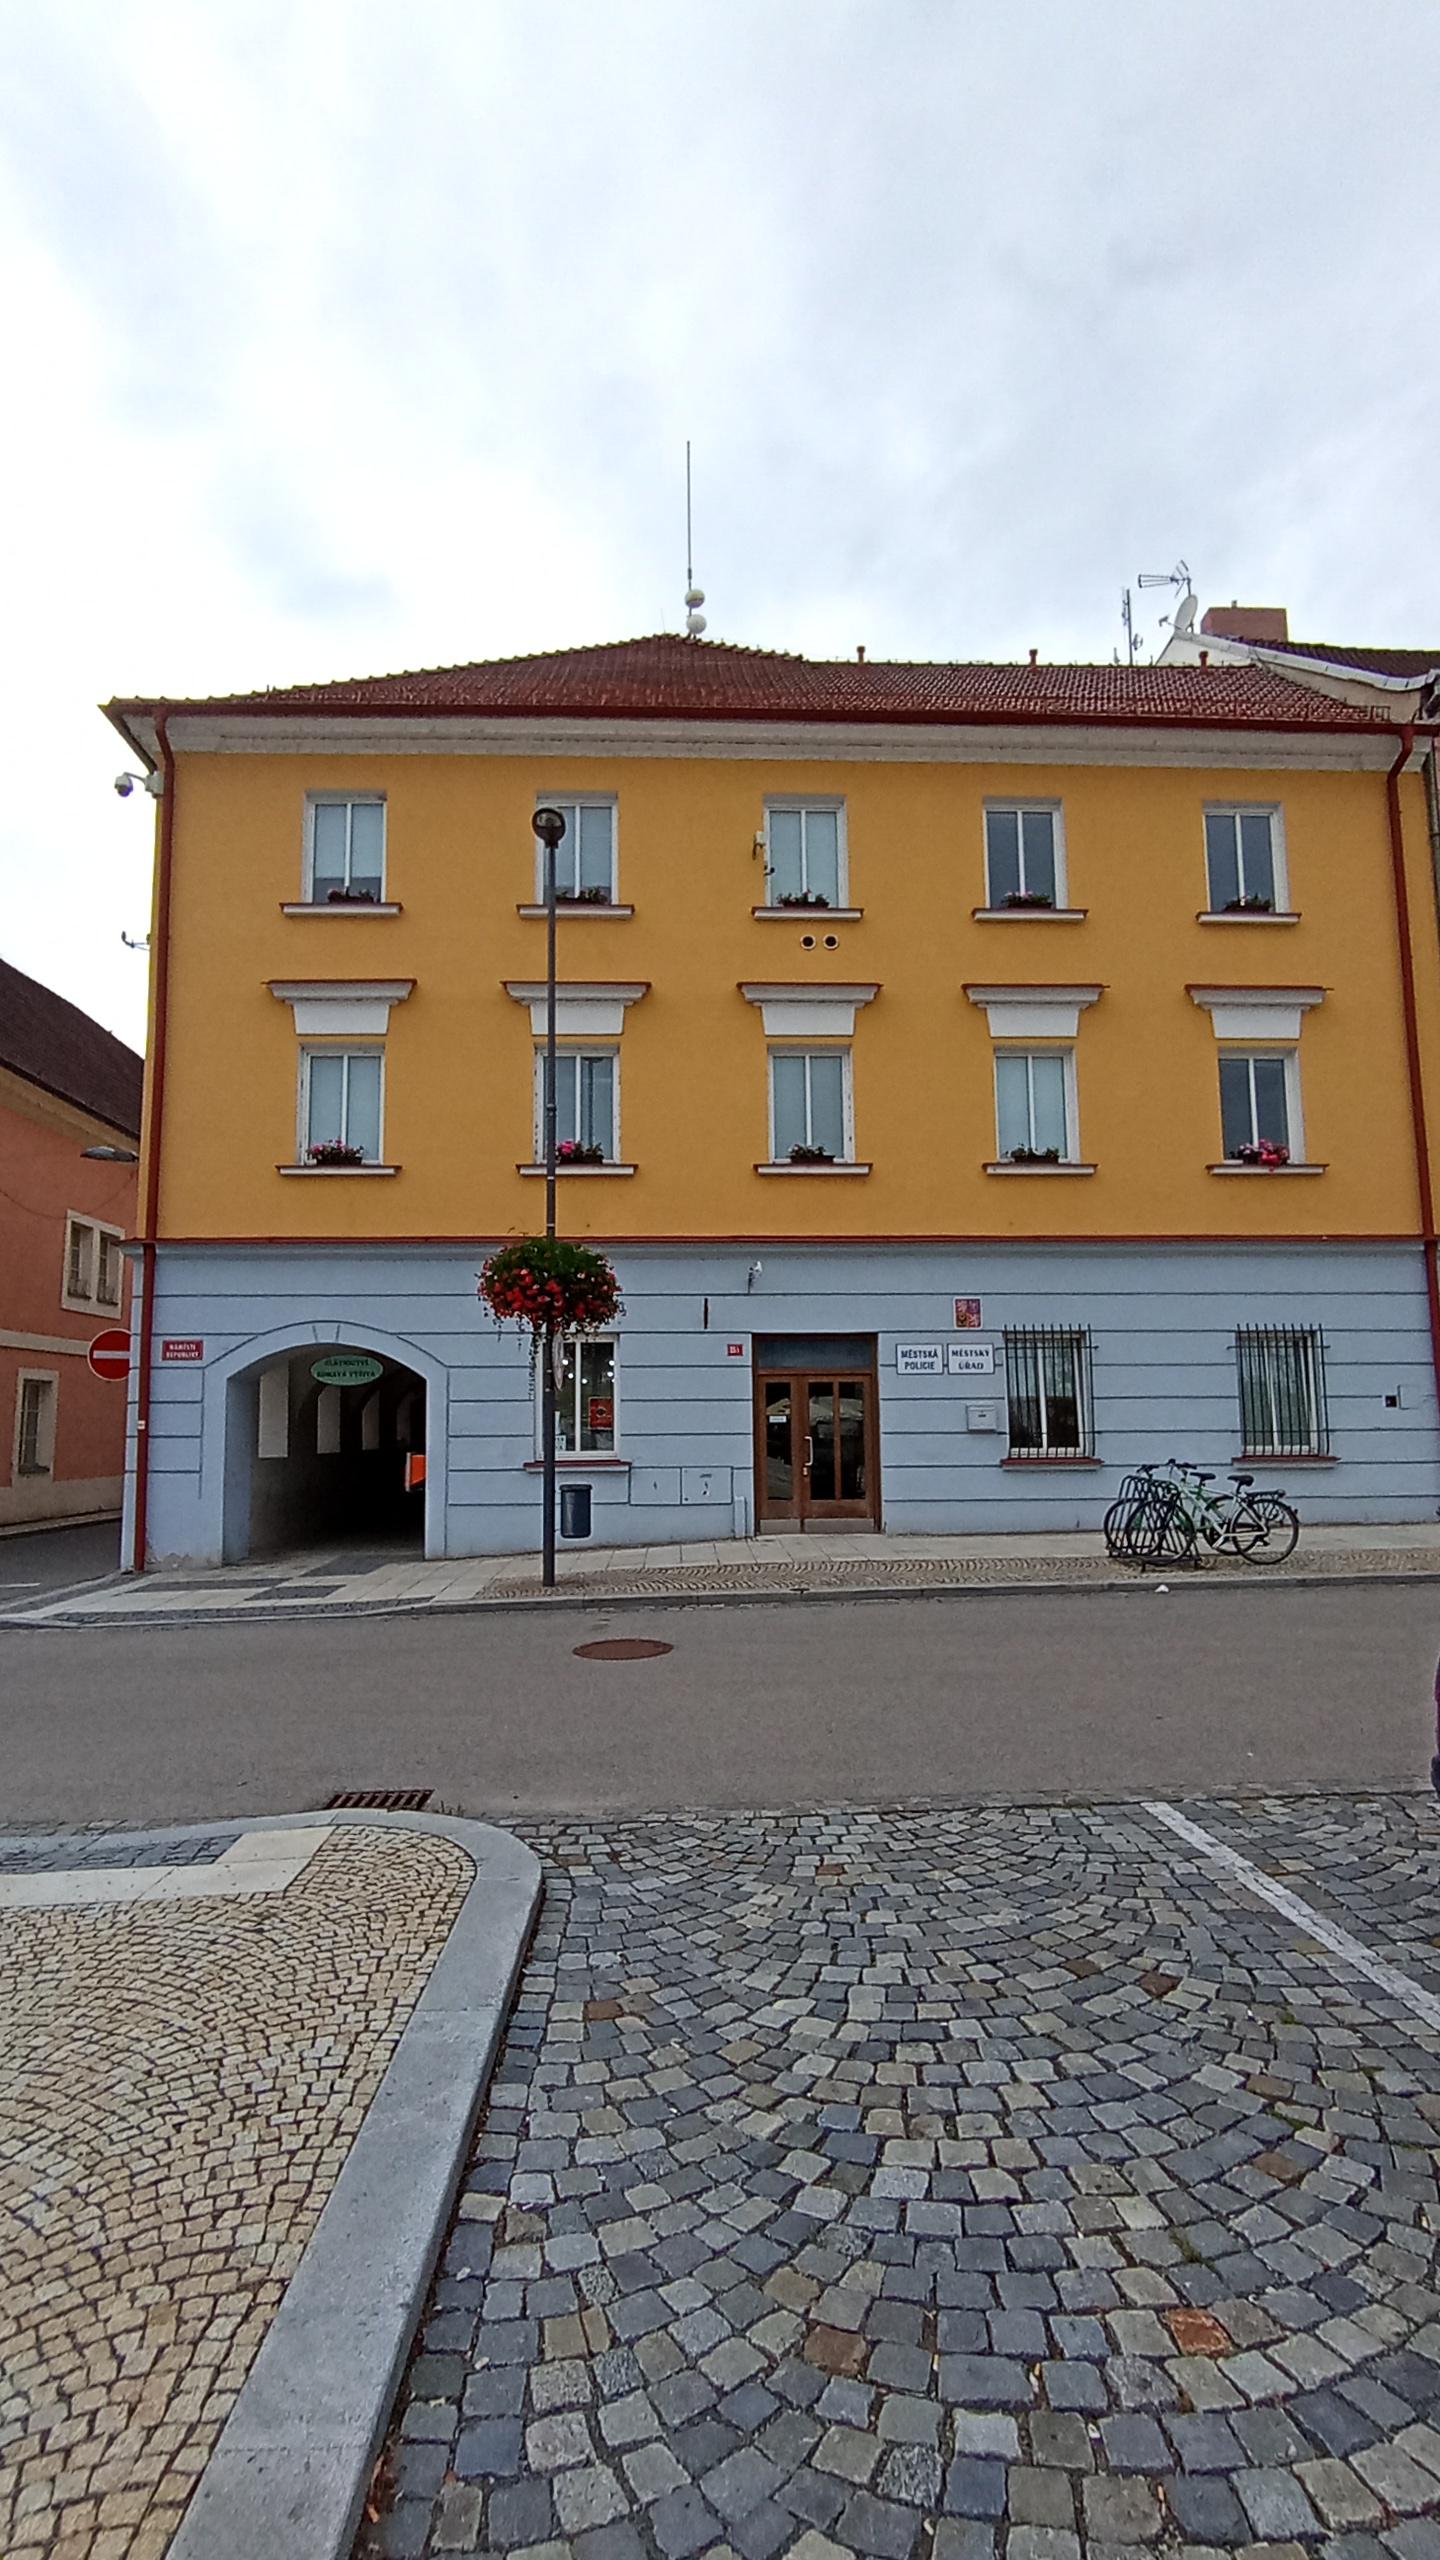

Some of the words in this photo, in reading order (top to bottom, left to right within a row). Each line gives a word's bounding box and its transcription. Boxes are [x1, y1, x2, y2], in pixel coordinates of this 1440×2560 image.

[901, 1349, 938, 1358] MĚSTSKÁ
[905, 1361, 935, 1370] POLICIE
[958, 1361, 984, 1370] ÚŘAD
